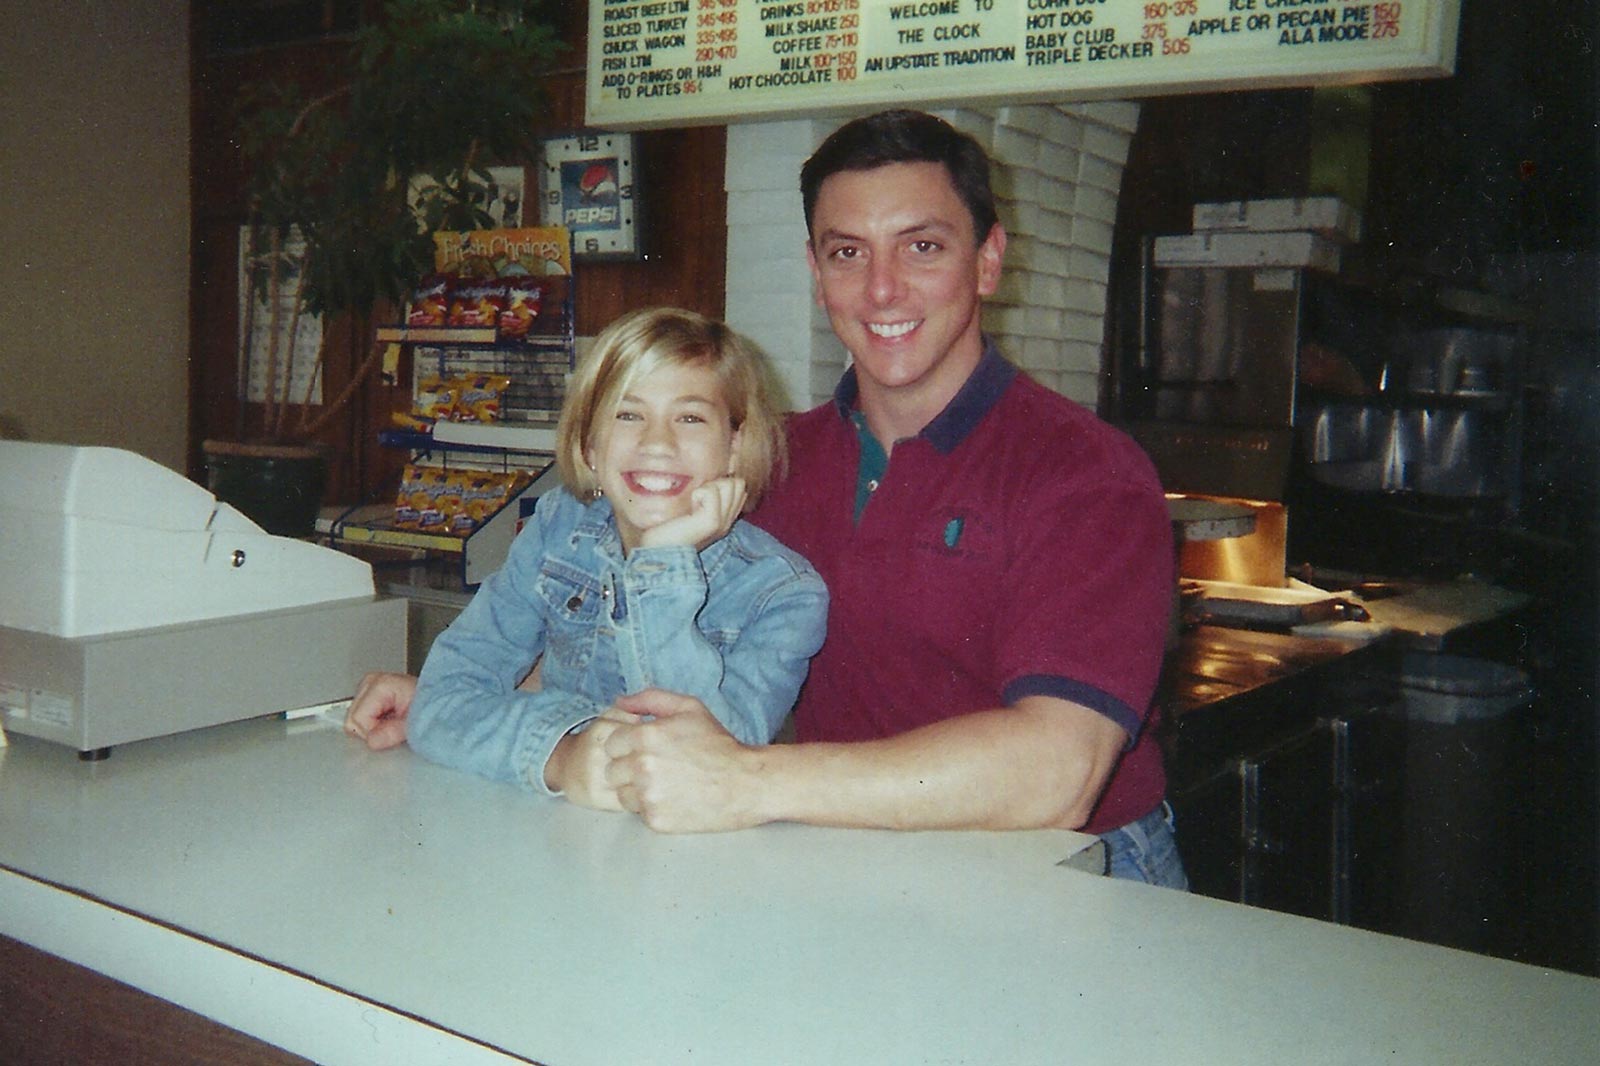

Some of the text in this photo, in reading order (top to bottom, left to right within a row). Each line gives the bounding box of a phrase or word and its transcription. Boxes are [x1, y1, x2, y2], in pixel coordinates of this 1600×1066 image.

[604, 6, 640, 21] ROAST
[641, 2, 667, 17] BEEF
[760, 3, 804, 21] DRINKS
[890, 0, 993, 20] WELCOME TO
[1026, 14, 1056, 30] HOT
[1060, 10, 1093, 27] DOG
[603, 22, 641, 38] SLICED
[647, 17, 688, 34] TURKEY
[765, 14, 859, 37] MILK SHAKE 250
[1187, 16, 1242, 37] APPLE
[1246, 14, 1270, 31] OR
[1277, 8, 1336, 29] PECAN
[1342, 5, 1369, 23] PIE
[1318, 23, 1369, 42] MODE
[1372, 20, 1400, 39] 275
[898, 23, 981, 44] THE CLOCK
[1025, 22, 1167, 50] BABY CLUB 375
[603, 39, 638, 55] CHUCK
[645, 34, 686, 50] WAGON
[773, 38, 822, 54] COFFEE
[1025, 37, 1191, 66] TRIPLE DECKER 505
[602, 57, 626, 71] FISH
[780, 55, 811, 71] MILK
[864, 46, 1015, 73] AN UPSTATE TRADITION
[602, 64, 722, 87] ADD O-RINGS OR H&H
[729, 67, 857, 90] HOT CHOCOLATE 100
[617, 86, 631, 99] TO
[637, 81, 681, 98] PLATES
[579, 136, 599, 152] 12
[549, 190, 559, 205] 9
[621, 185, 632, 199] 3
[565, 206, 617, 224] PEPSI
[490, 235, 562, 261] Choices
[585, 238, 599, 252] 6
